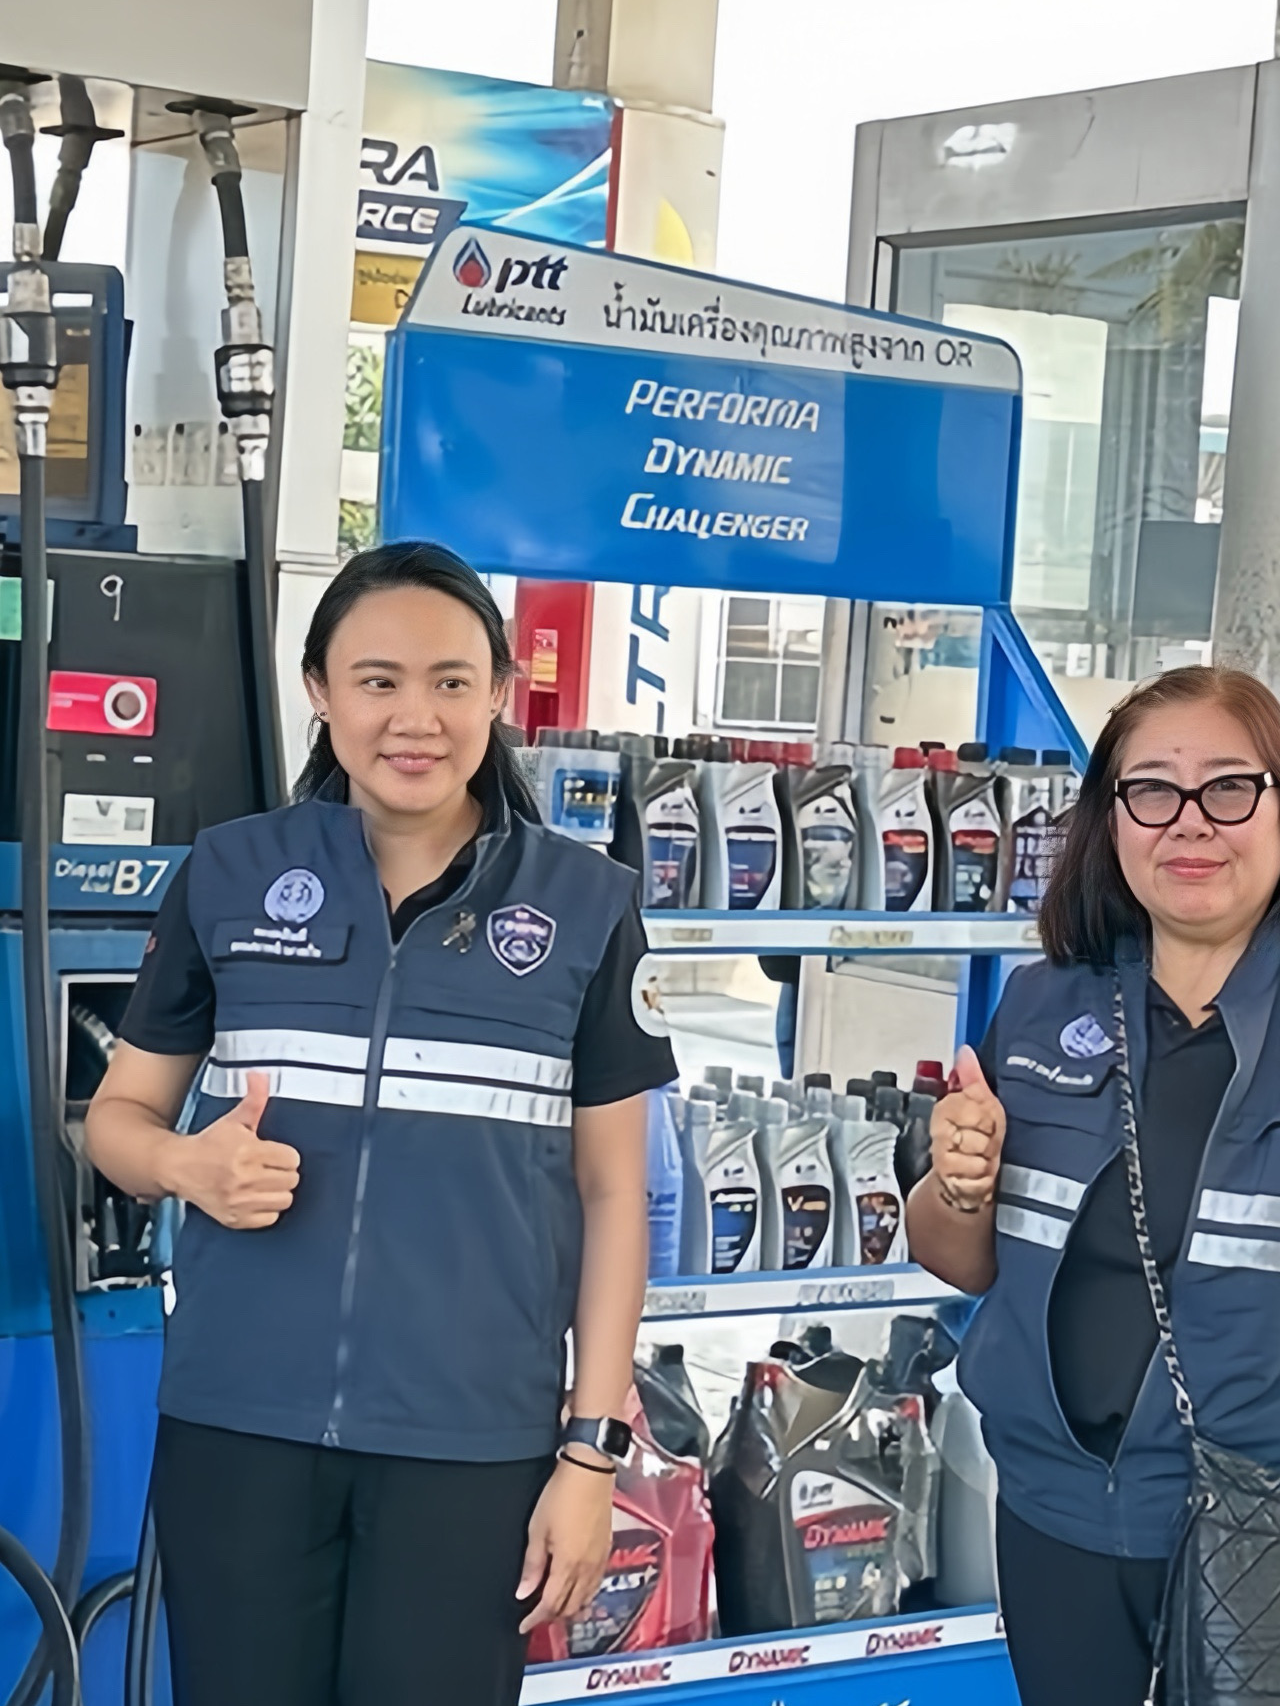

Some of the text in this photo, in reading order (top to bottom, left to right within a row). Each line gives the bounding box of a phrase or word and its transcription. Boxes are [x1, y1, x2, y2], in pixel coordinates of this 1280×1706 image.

[358, 201, 441, 235] RCE
[495, 254, 569, 294] ptt
[461, 292, 567, 326] Lubricants
[935, 339, 973, 368] OR
[624, 379, 820, 433] PERFORMA
[643, 437, 794, 485] DYNAMIC
[99, 574, 124, 622] 9
[112, 859, 170, 897] B7
